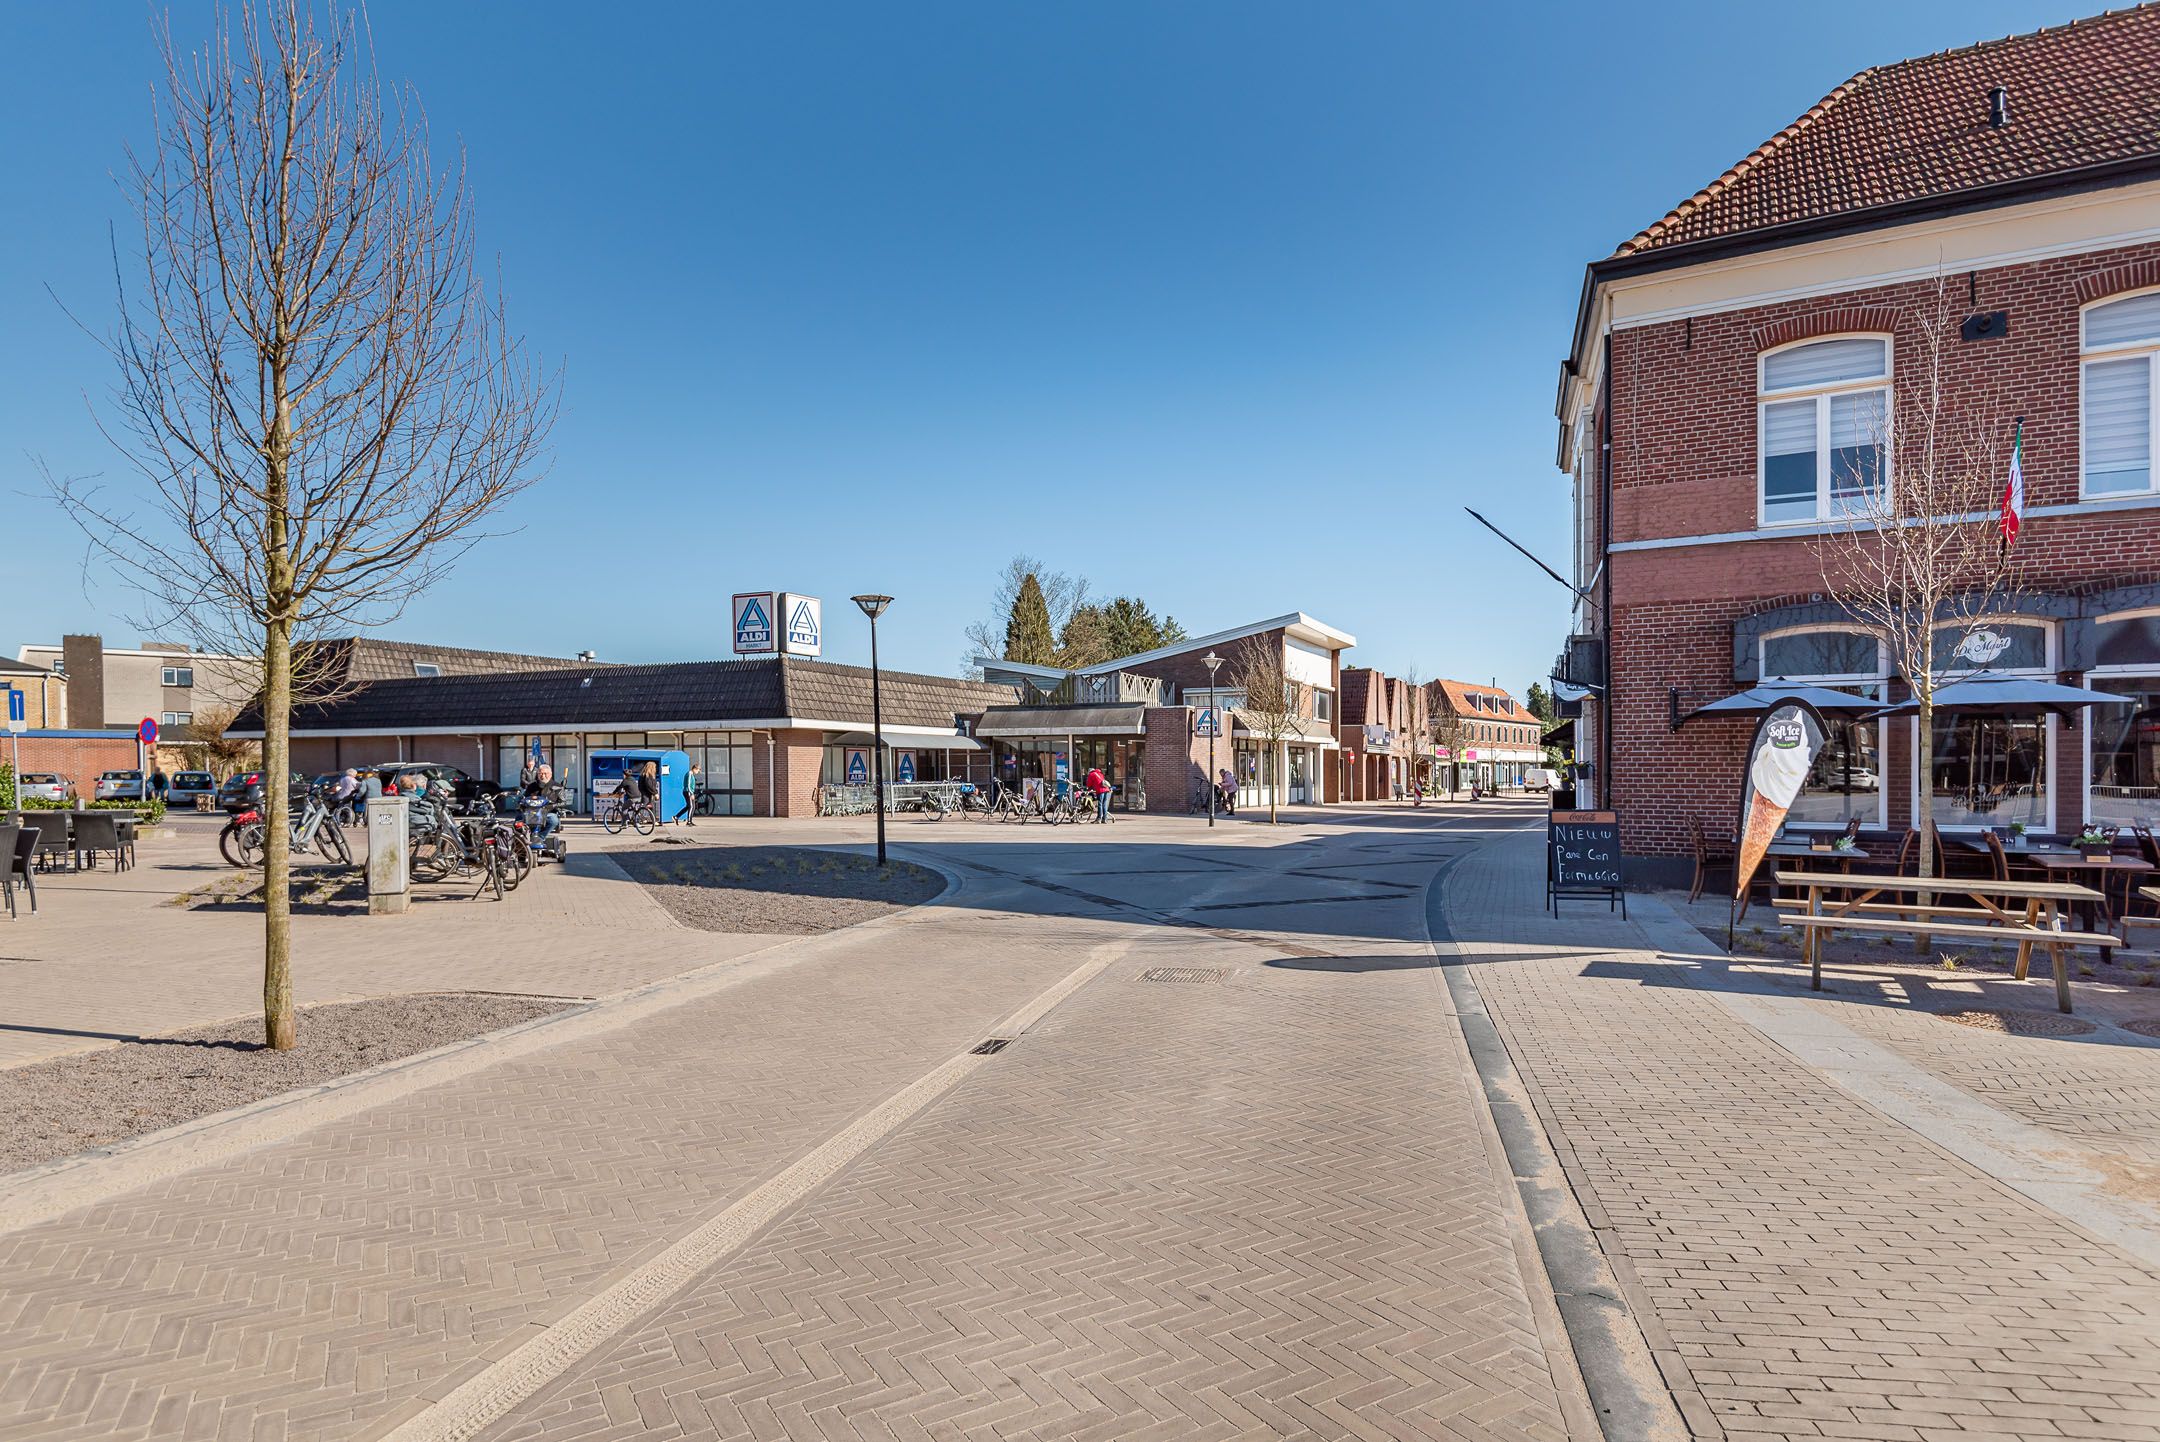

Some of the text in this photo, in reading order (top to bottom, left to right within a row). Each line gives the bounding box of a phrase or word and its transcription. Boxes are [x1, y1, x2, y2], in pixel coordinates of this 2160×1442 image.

[740, 632, 767, 641] ALDI
[791, 633, 815, 645] ALDI
[1770, 724, 1800, 740] Soft Ice
[1587, 848, 1609, 861] Con
